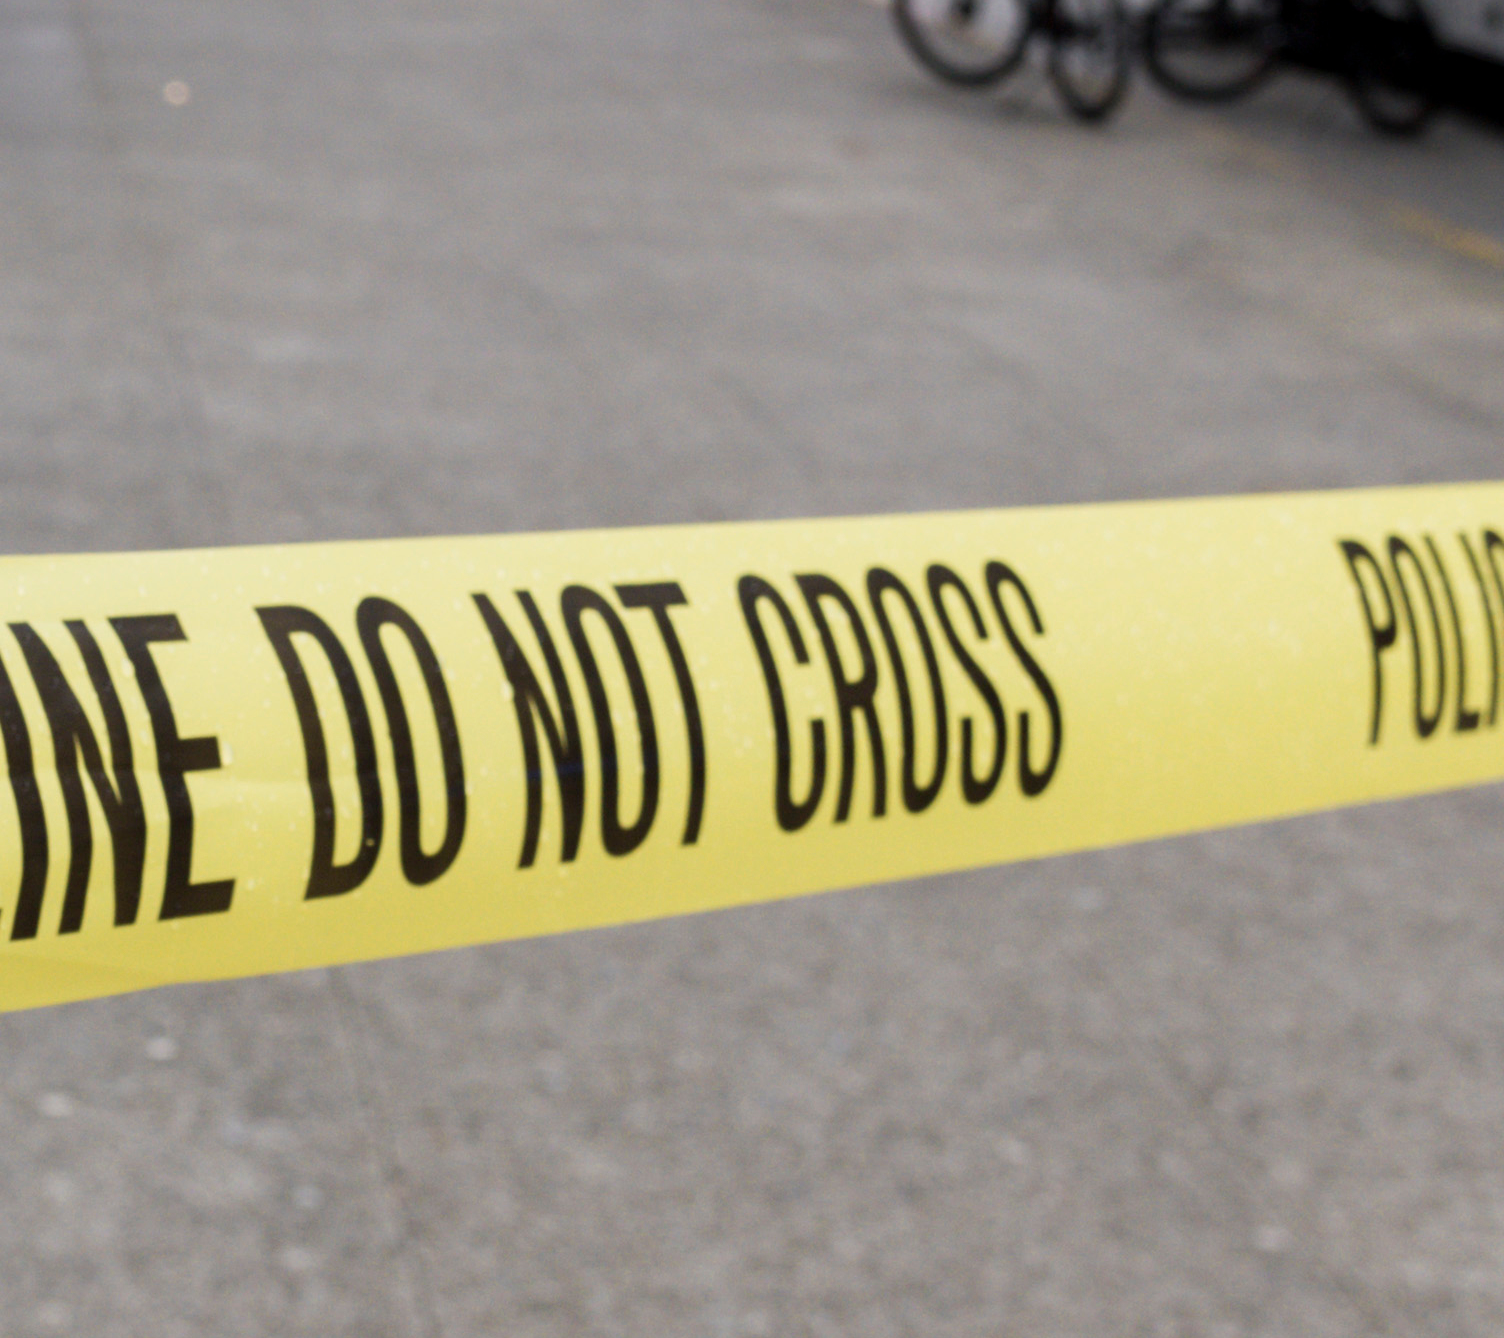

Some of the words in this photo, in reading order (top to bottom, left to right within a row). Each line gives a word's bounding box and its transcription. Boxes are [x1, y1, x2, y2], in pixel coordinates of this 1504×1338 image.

[253, 597, 468, 903] DO
[469, 581, 708, 870] NOT
[736, 559, 1064, 832] CROSS
